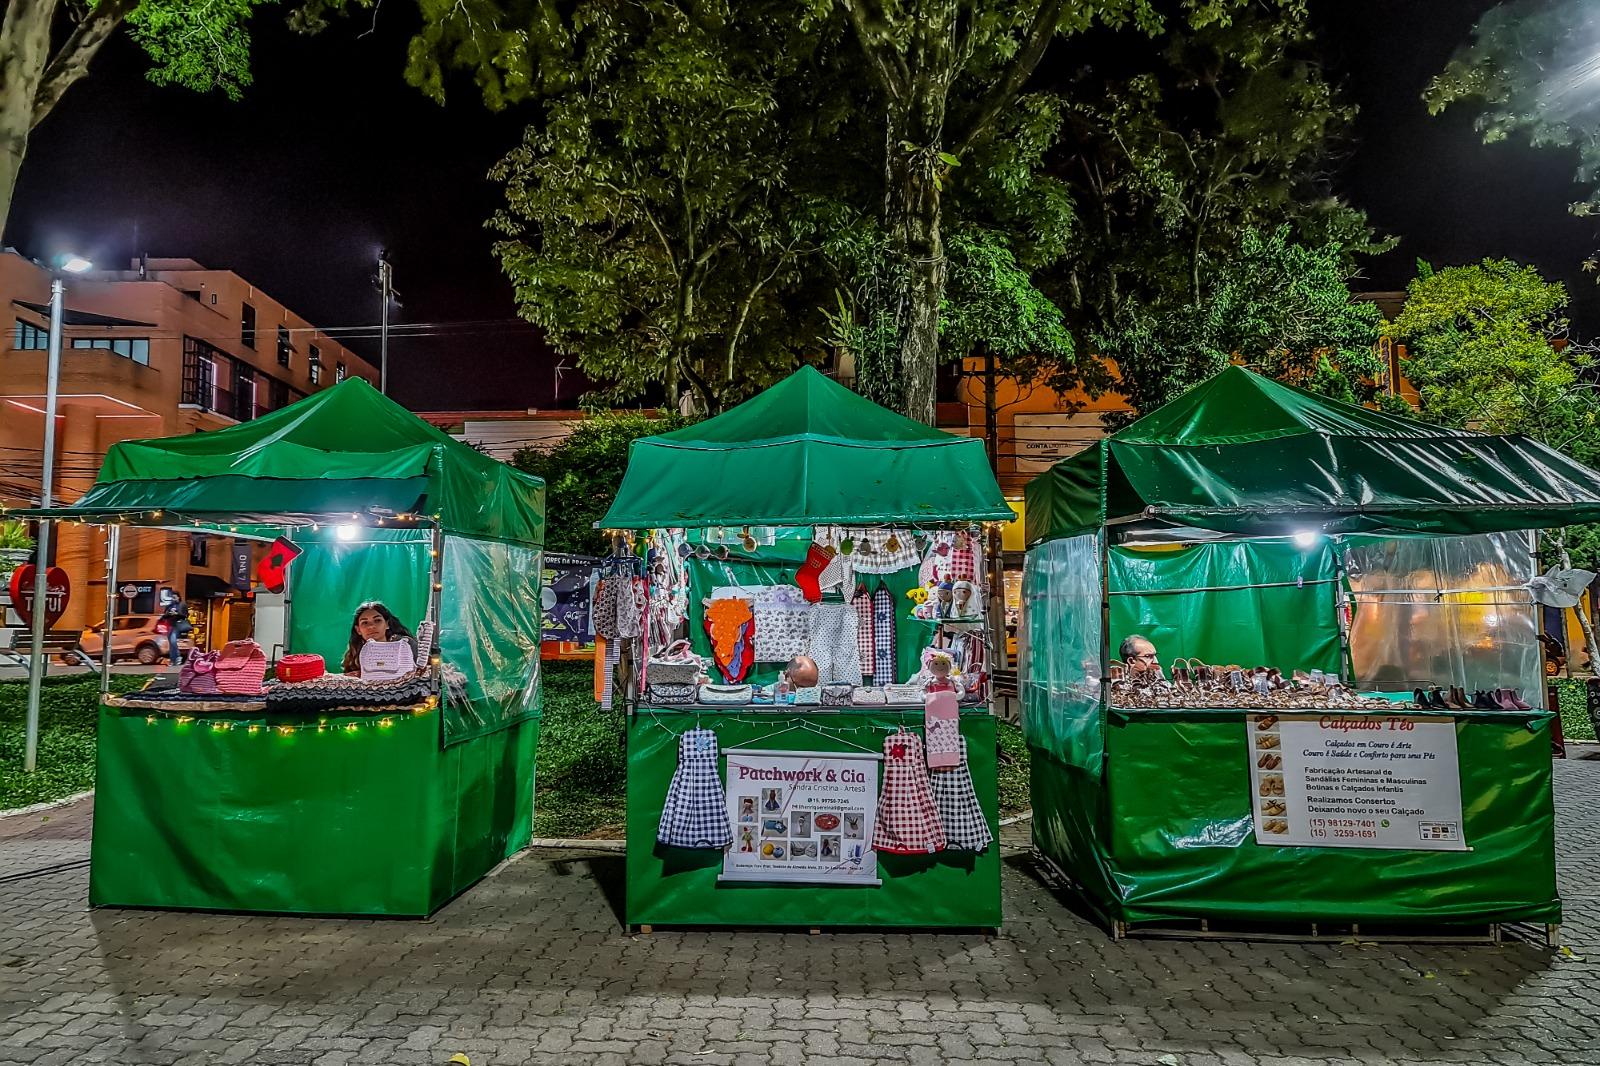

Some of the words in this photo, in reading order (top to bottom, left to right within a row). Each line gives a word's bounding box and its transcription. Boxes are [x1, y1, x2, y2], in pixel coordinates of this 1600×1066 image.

[24, 593, 62, 612] TUÍ
[1319, 715, 1382, 733] Calçados
[1386, 716, 1415, 731] Téo
[1325, 740, 1355, 749] Calçados
[1368, 741, 1389, 749] Couro
[1396, 742, 1412, 750] Arte
[1303, 749, 1324, 757] Couro
[1331, 750, 1352, 758] Saúde
[1359, 751, 1388, 760] Conforto
[1390, 753, 1406, 761] para
[739, 766, 822, 782] Patchwork
[826, 769, 837, 783] &
[841, 769, 866, 784] Cia
[1304, 766, 1345, 777] Fabricação
[1305, 775, 1341, 783] Sandálias
[1342, 776, 1378, 784] Femininas
[1386, 777, 1427, 785] Masculinas
[788, 784, 812, 792] Sandra
[813, 784, 839, 792] Cristina
[844, 785, 866, 793] Artesã
[1341, 784, 1375, 793] Calçados
[1376, 785, 1404, 793] Infantis
[1307, 796, 1353, 804] Realizamos
[1355, 797, 1396, 805] Consertos
[1308, 805, 1346, 814] Deixando
[1348, 807, 1367, 815] novo
[1391, 807, 1425, 817] Calçado
[1309, 818, 1326, 828] (15)
[1327, 818, 1376, 828] 98129-7401
[1310, 829, 1327, 838] (15)
[1334, 829, 1377, 838] 3259-1691
